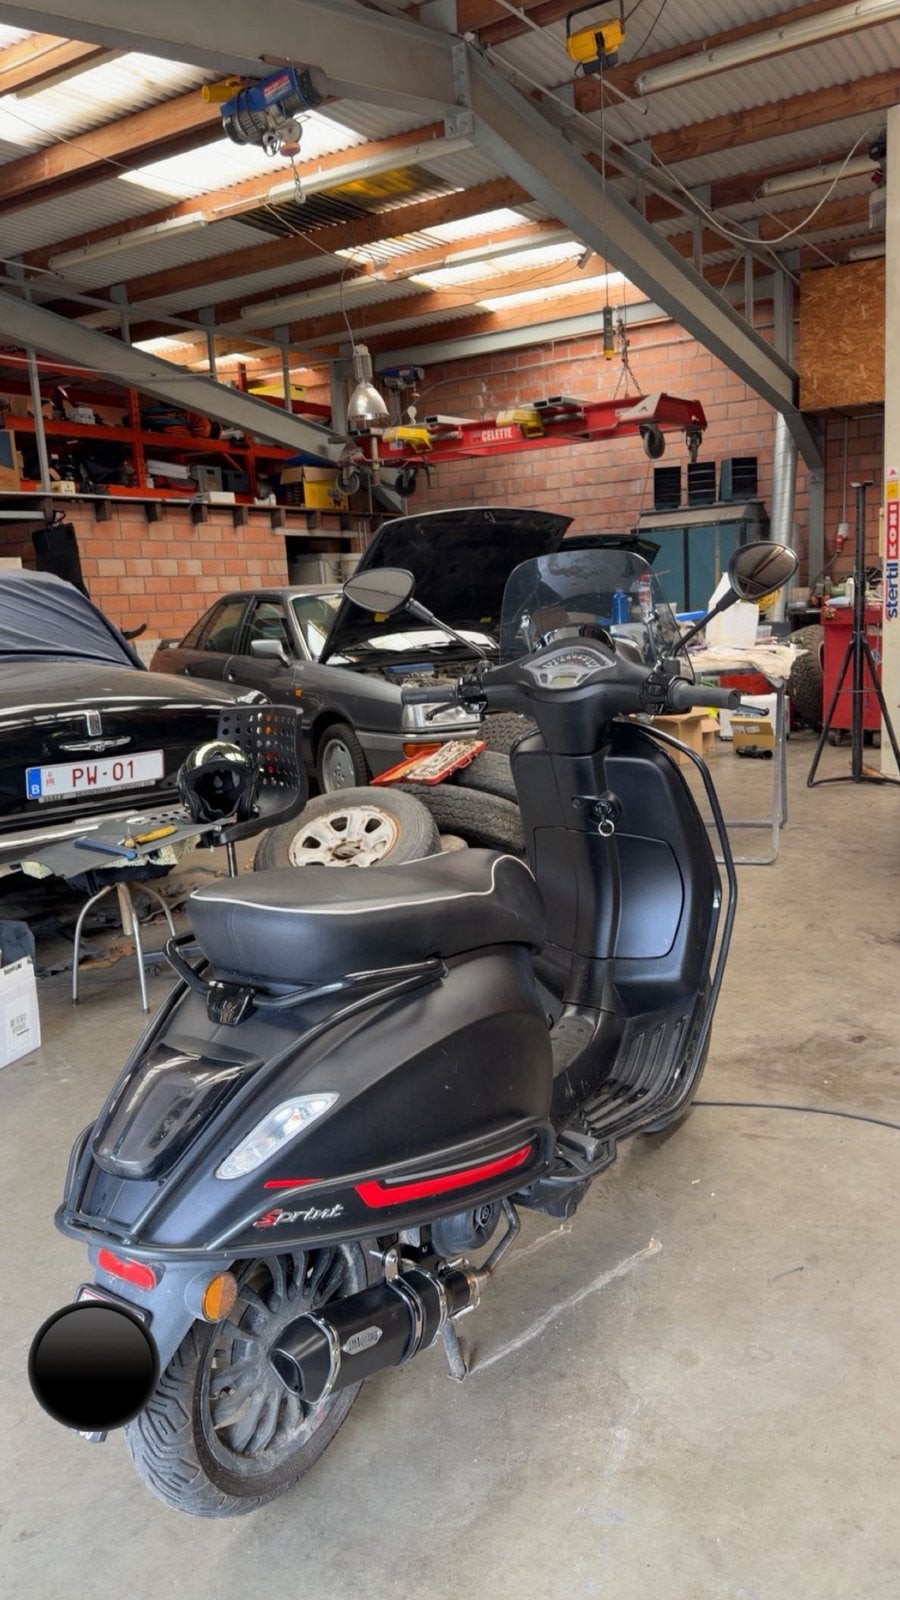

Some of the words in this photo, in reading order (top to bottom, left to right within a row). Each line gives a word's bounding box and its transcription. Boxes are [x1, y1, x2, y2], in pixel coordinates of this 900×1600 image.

[481, 427, 512, 442] CELETTE
[889, 504, 898, 557] KONI
[886, 562, 899, 619] stertil
[72, 760, 134, 788] PW-01
[31, 784, 40, 795] B
[252, 1203, 344, 1228] Sprint
